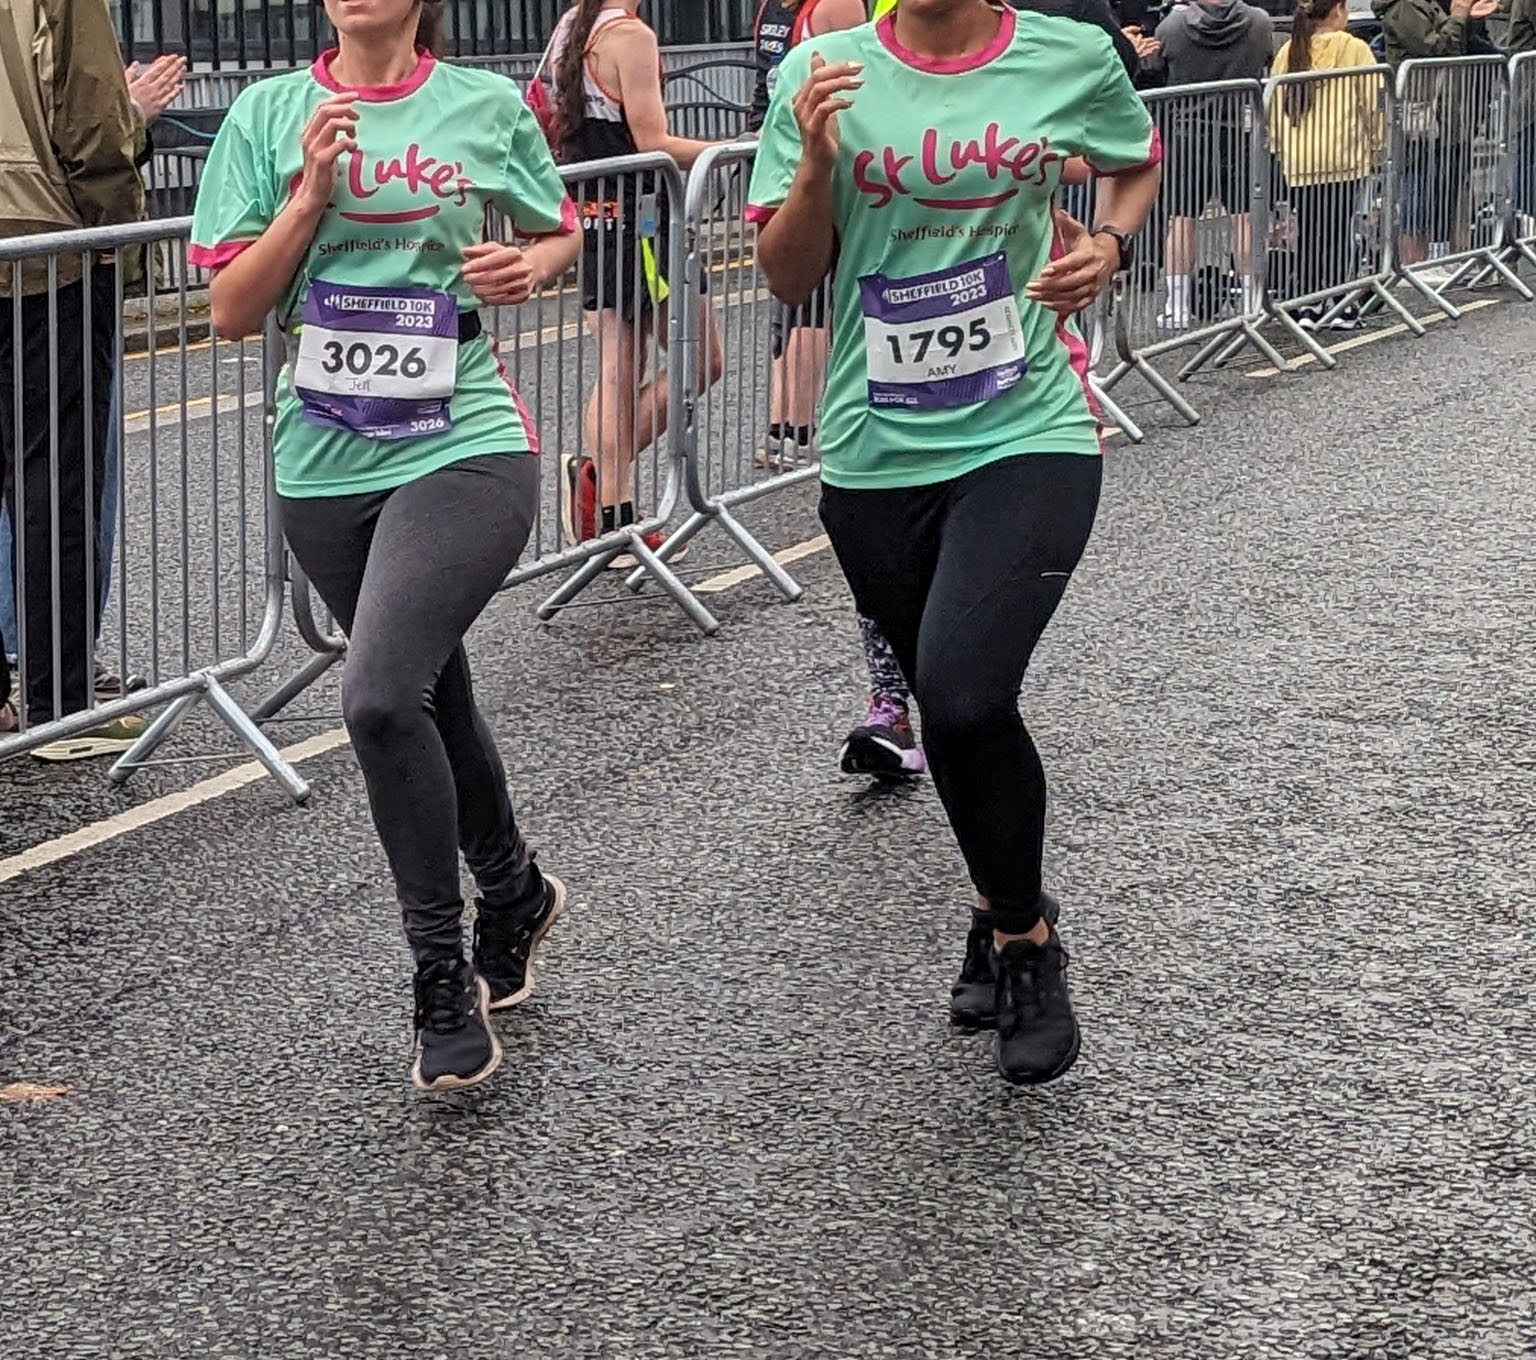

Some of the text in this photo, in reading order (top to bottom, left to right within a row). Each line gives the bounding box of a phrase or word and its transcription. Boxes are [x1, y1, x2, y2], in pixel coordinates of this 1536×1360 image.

[348, 143, 477, 206] Luke's
[854, 122, 1058, 208] St Luke's
[891, 271, 982, 301] SHEFFIELD 10K
[950, 285, 987, 307] 2023
[343, 297, 433, 313] SHEFFIELD 10K
[395, 314, 433, 328] 2023
[886, 317, 991, 364] 1795
[321, 341, 427, 379] 3026
[927, 364, 957, 377] AMY
[410, 418, 445, 432] 3026
